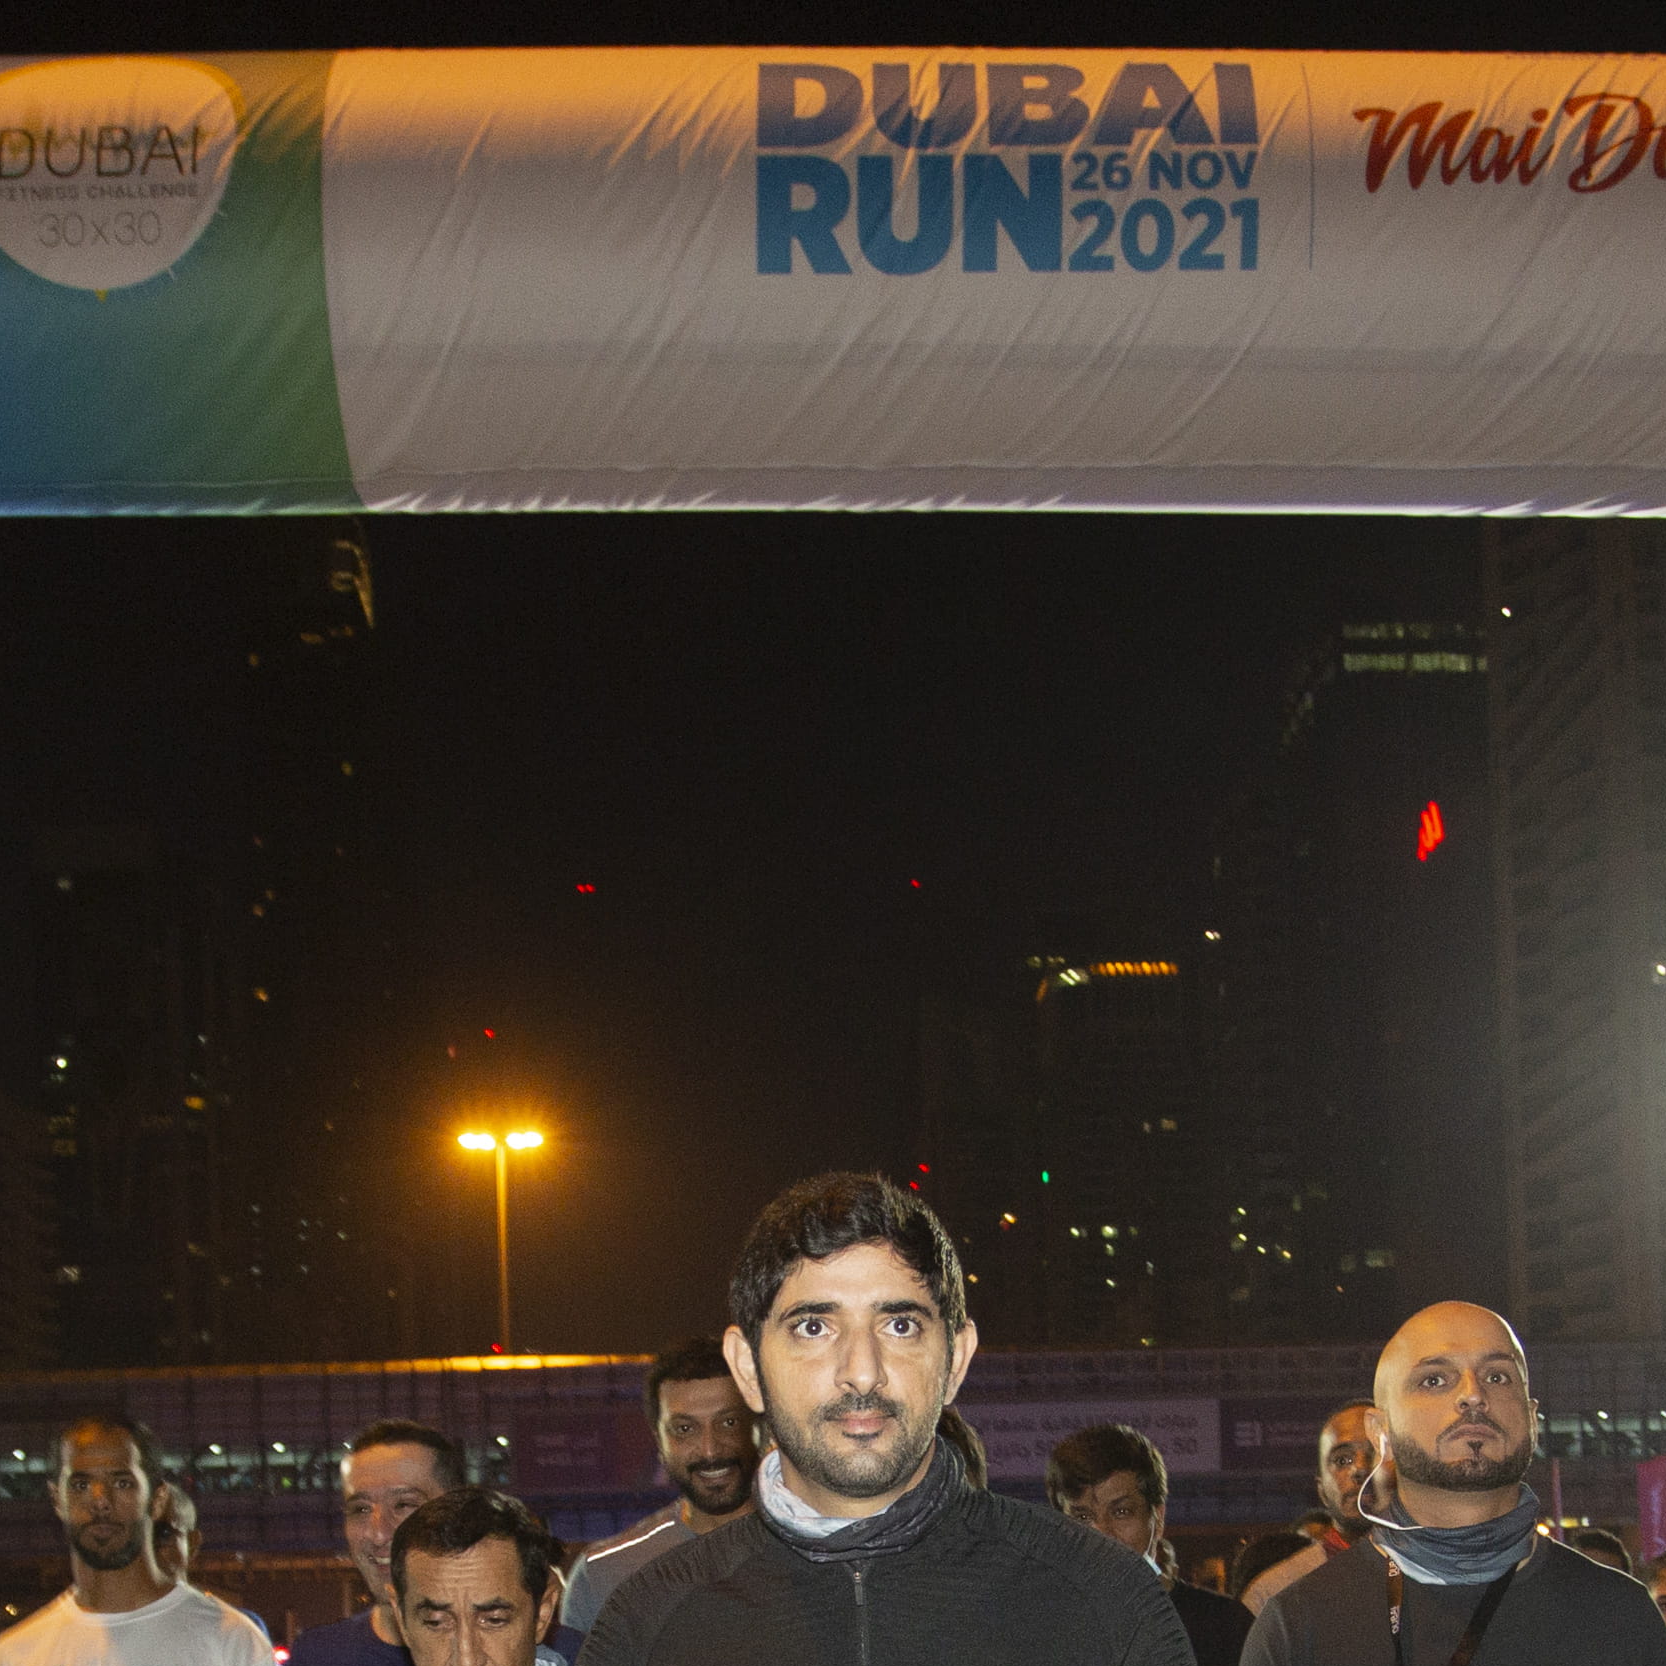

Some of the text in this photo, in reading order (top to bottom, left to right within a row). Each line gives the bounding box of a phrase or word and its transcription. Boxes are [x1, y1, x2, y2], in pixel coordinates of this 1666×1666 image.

[756, 62, 1260, 149] DUBAI
[1353, 100, 1550, 194] Mai
[37, 211, 162, 248] 30x30
[86, 181, 200, 200] CHALLENGE
[756, 151, 1257, 275] RUN 26 NOV
[1068, 197, 1260, 273] 2021
